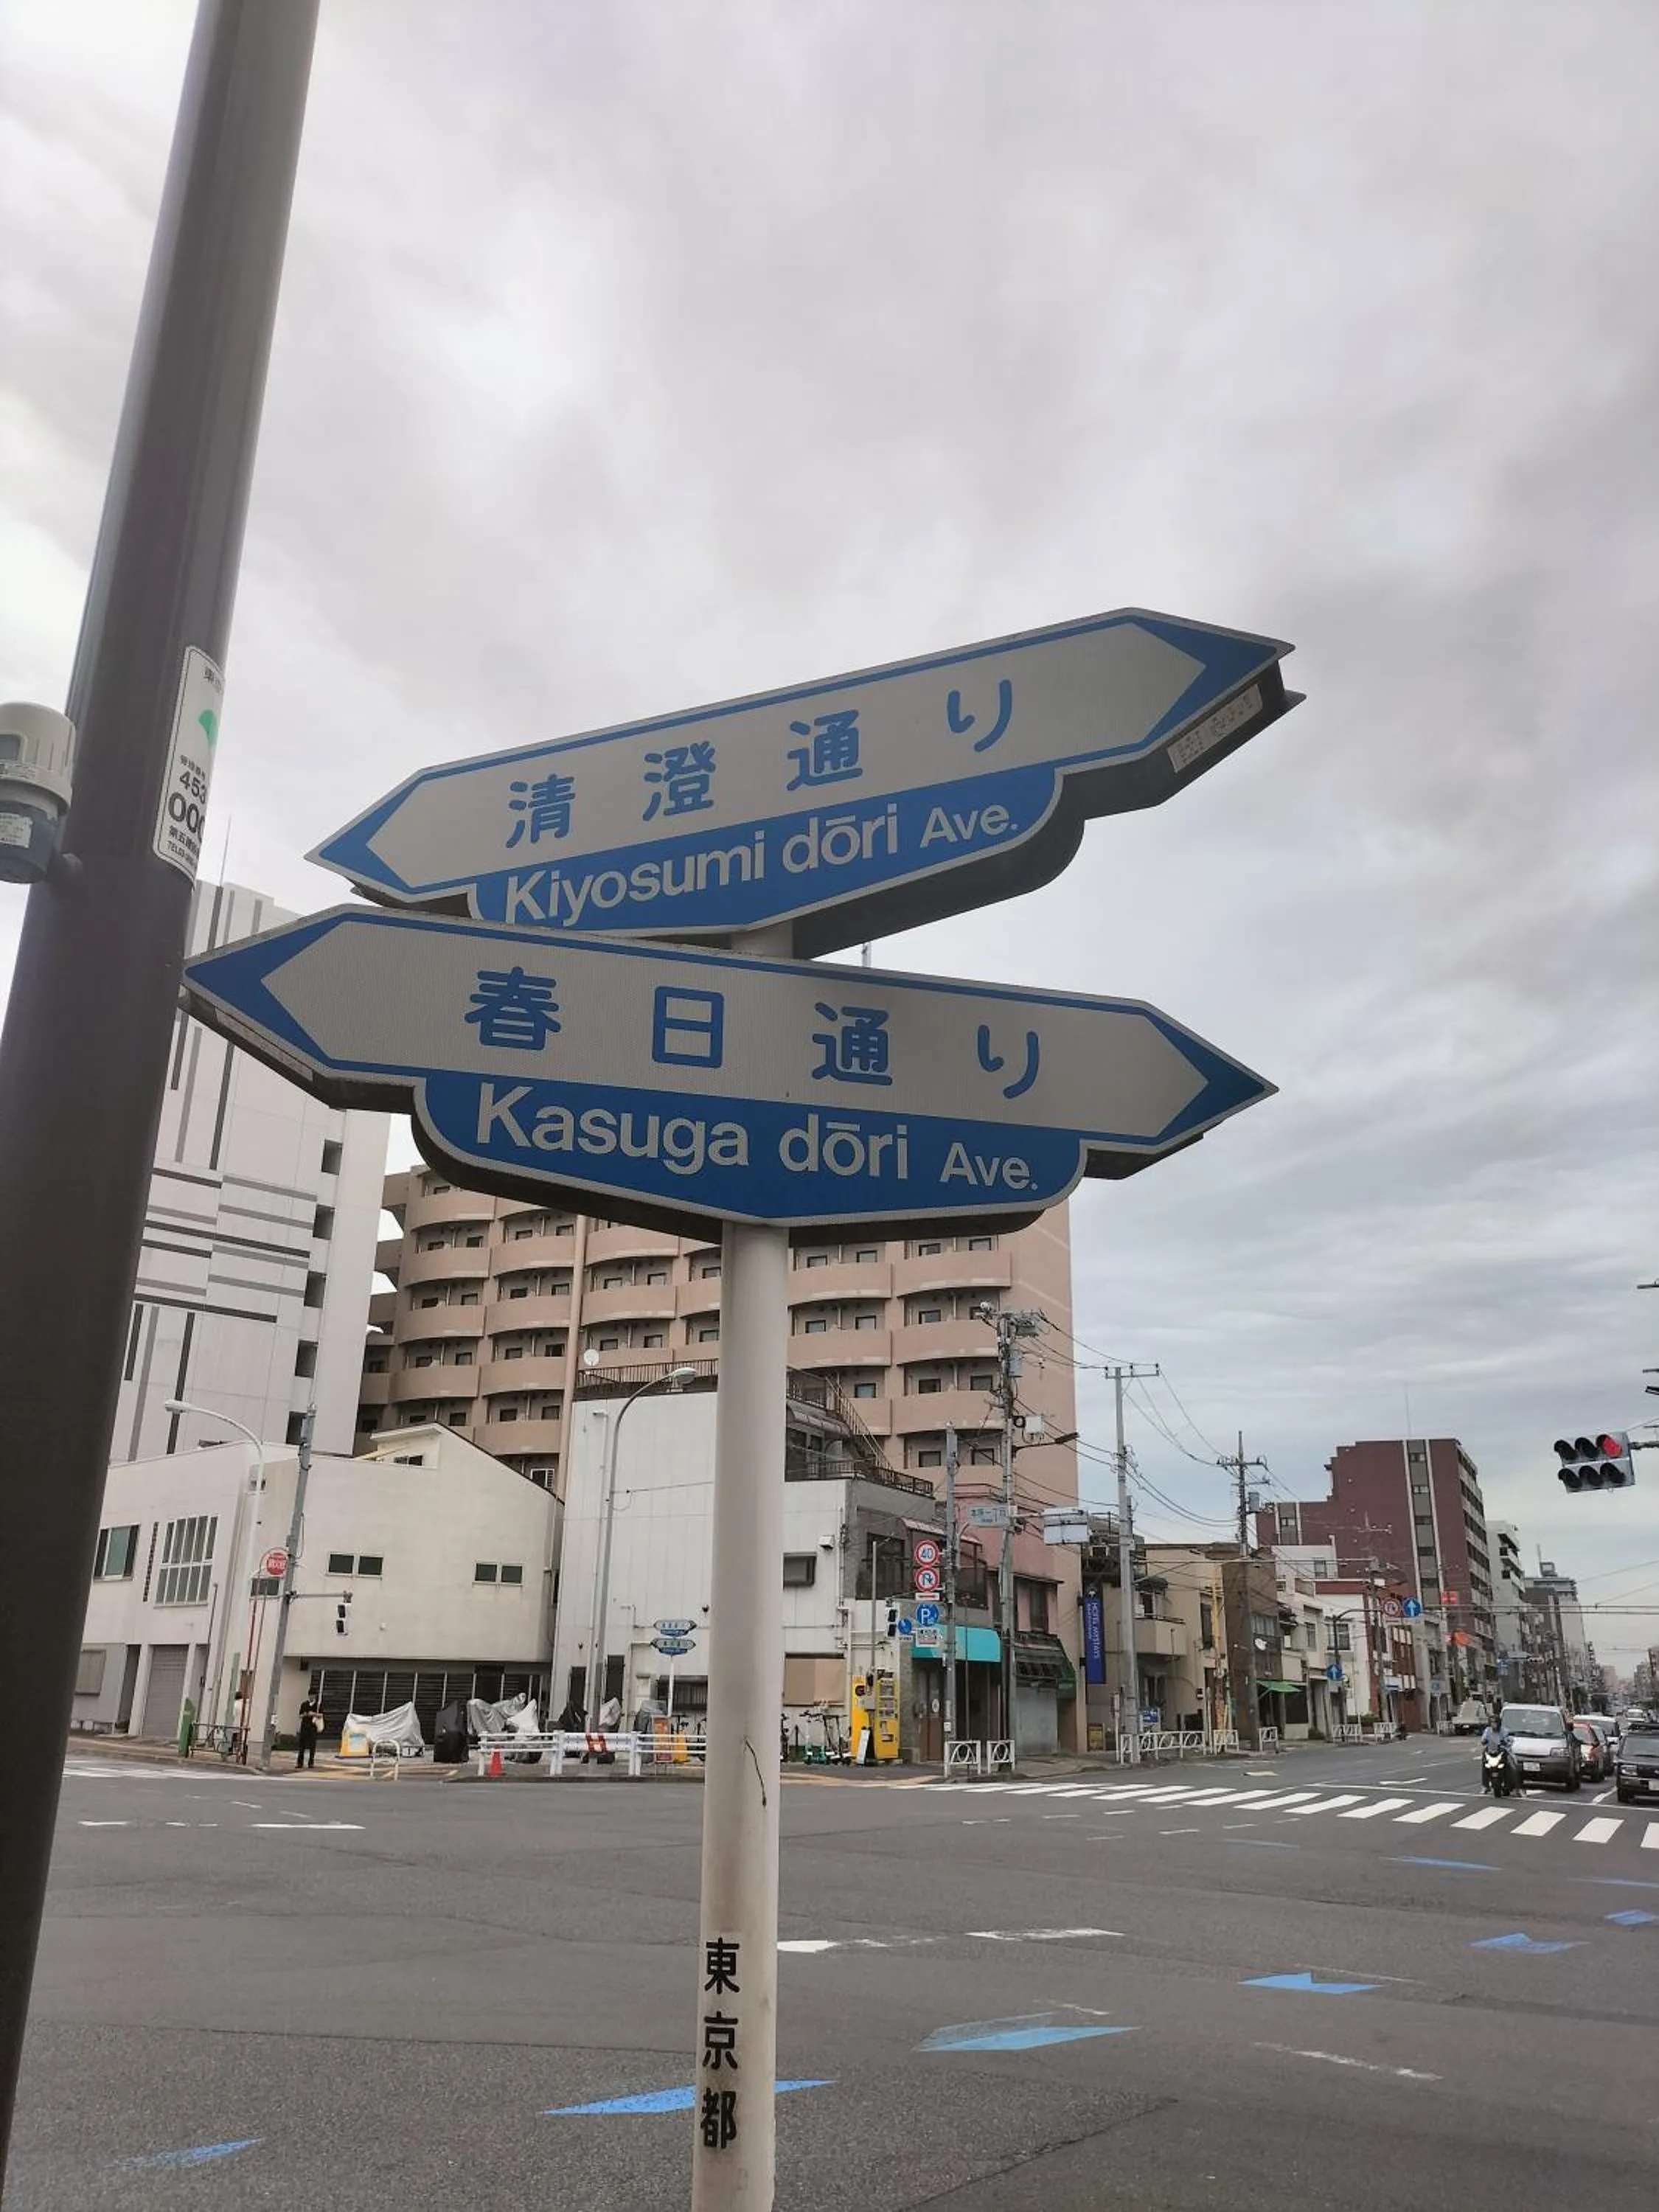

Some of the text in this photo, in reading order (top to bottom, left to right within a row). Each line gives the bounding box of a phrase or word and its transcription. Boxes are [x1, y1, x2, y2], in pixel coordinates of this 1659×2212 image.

[506, 679, 1012, 848] 清澄通り
[505, 803, 1018, 927] Kiyosumi dōri Ave.
[465, 966, 1039, 1099] 春日通り
[476, 1082, 1038, 1190] Kasuga dōri Ave.
[921, 1548, 933, 1559] 40
[921, 1608, 931, 1624] P
[700, 1937, 740, 2149] 東京都
